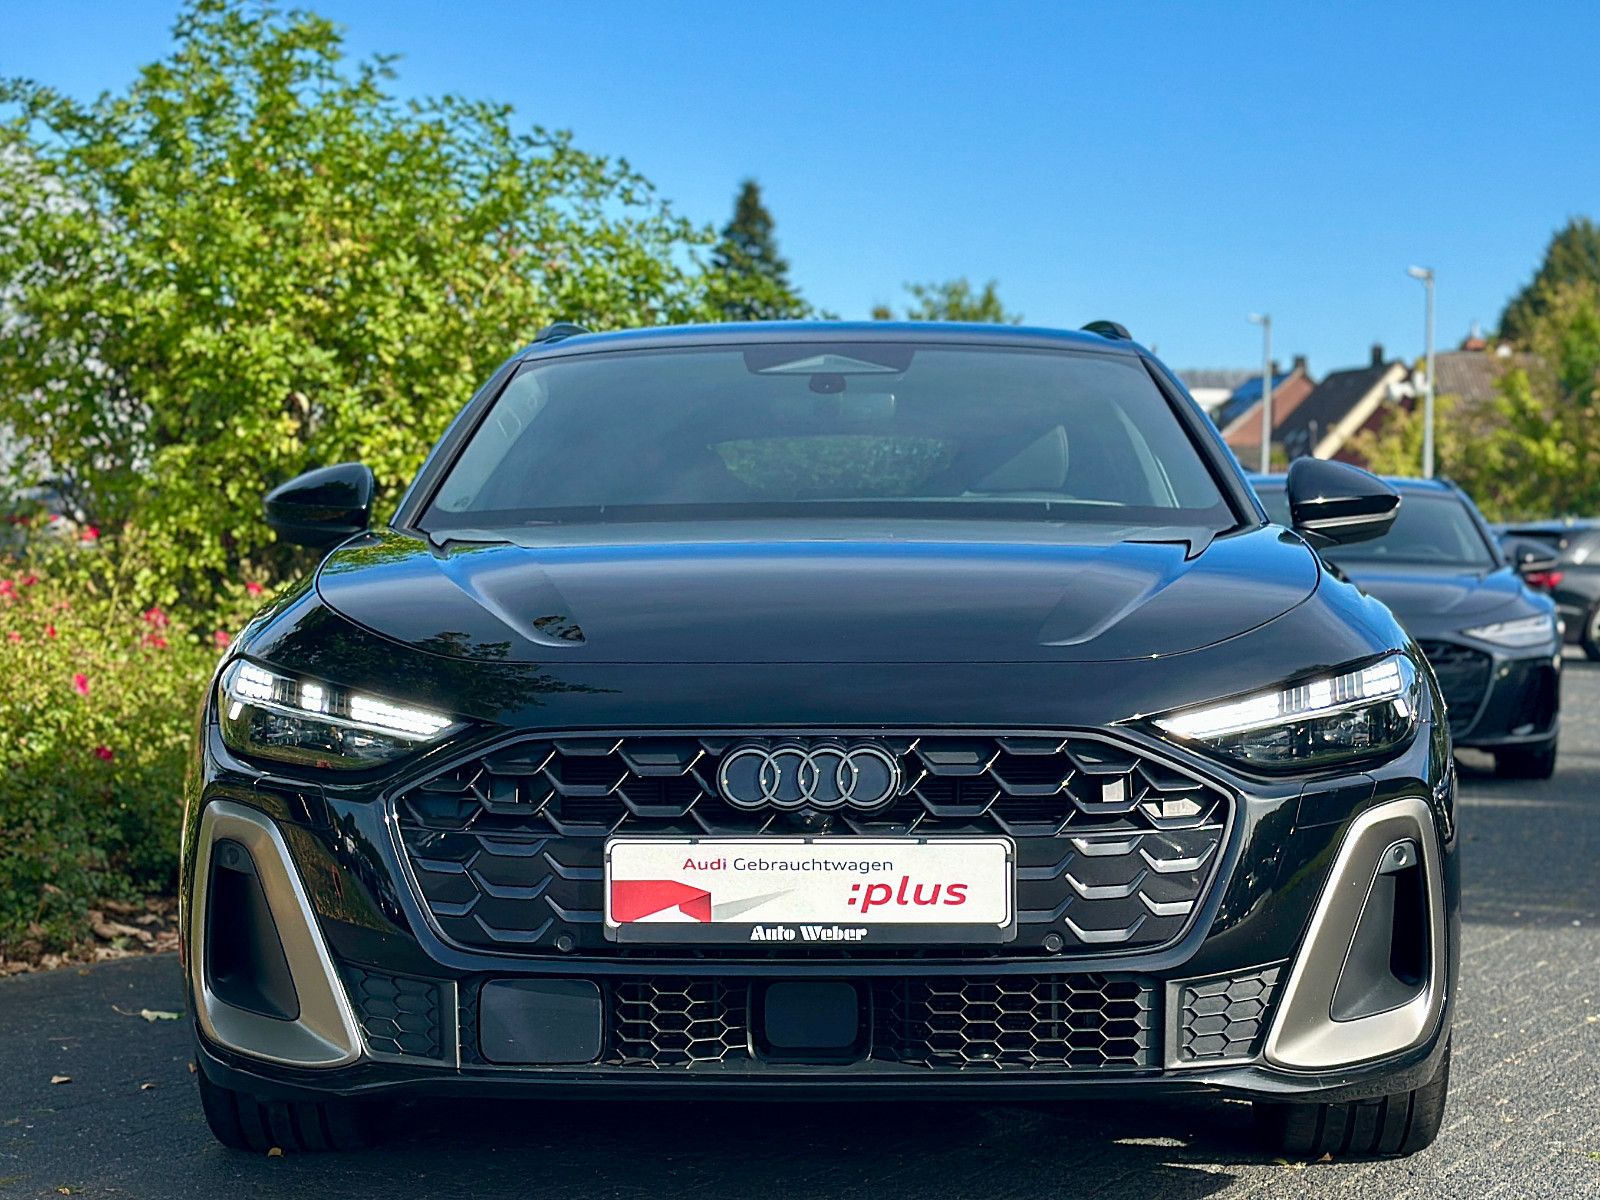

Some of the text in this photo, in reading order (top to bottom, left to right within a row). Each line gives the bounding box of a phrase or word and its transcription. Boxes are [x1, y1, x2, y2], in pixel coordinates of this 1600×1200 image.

[682, 857, 893, 874] Audi Gebrauchtwagen
[847, 876, 968, 913] :plus
[750, 925, 868, 941] Auto Weber
